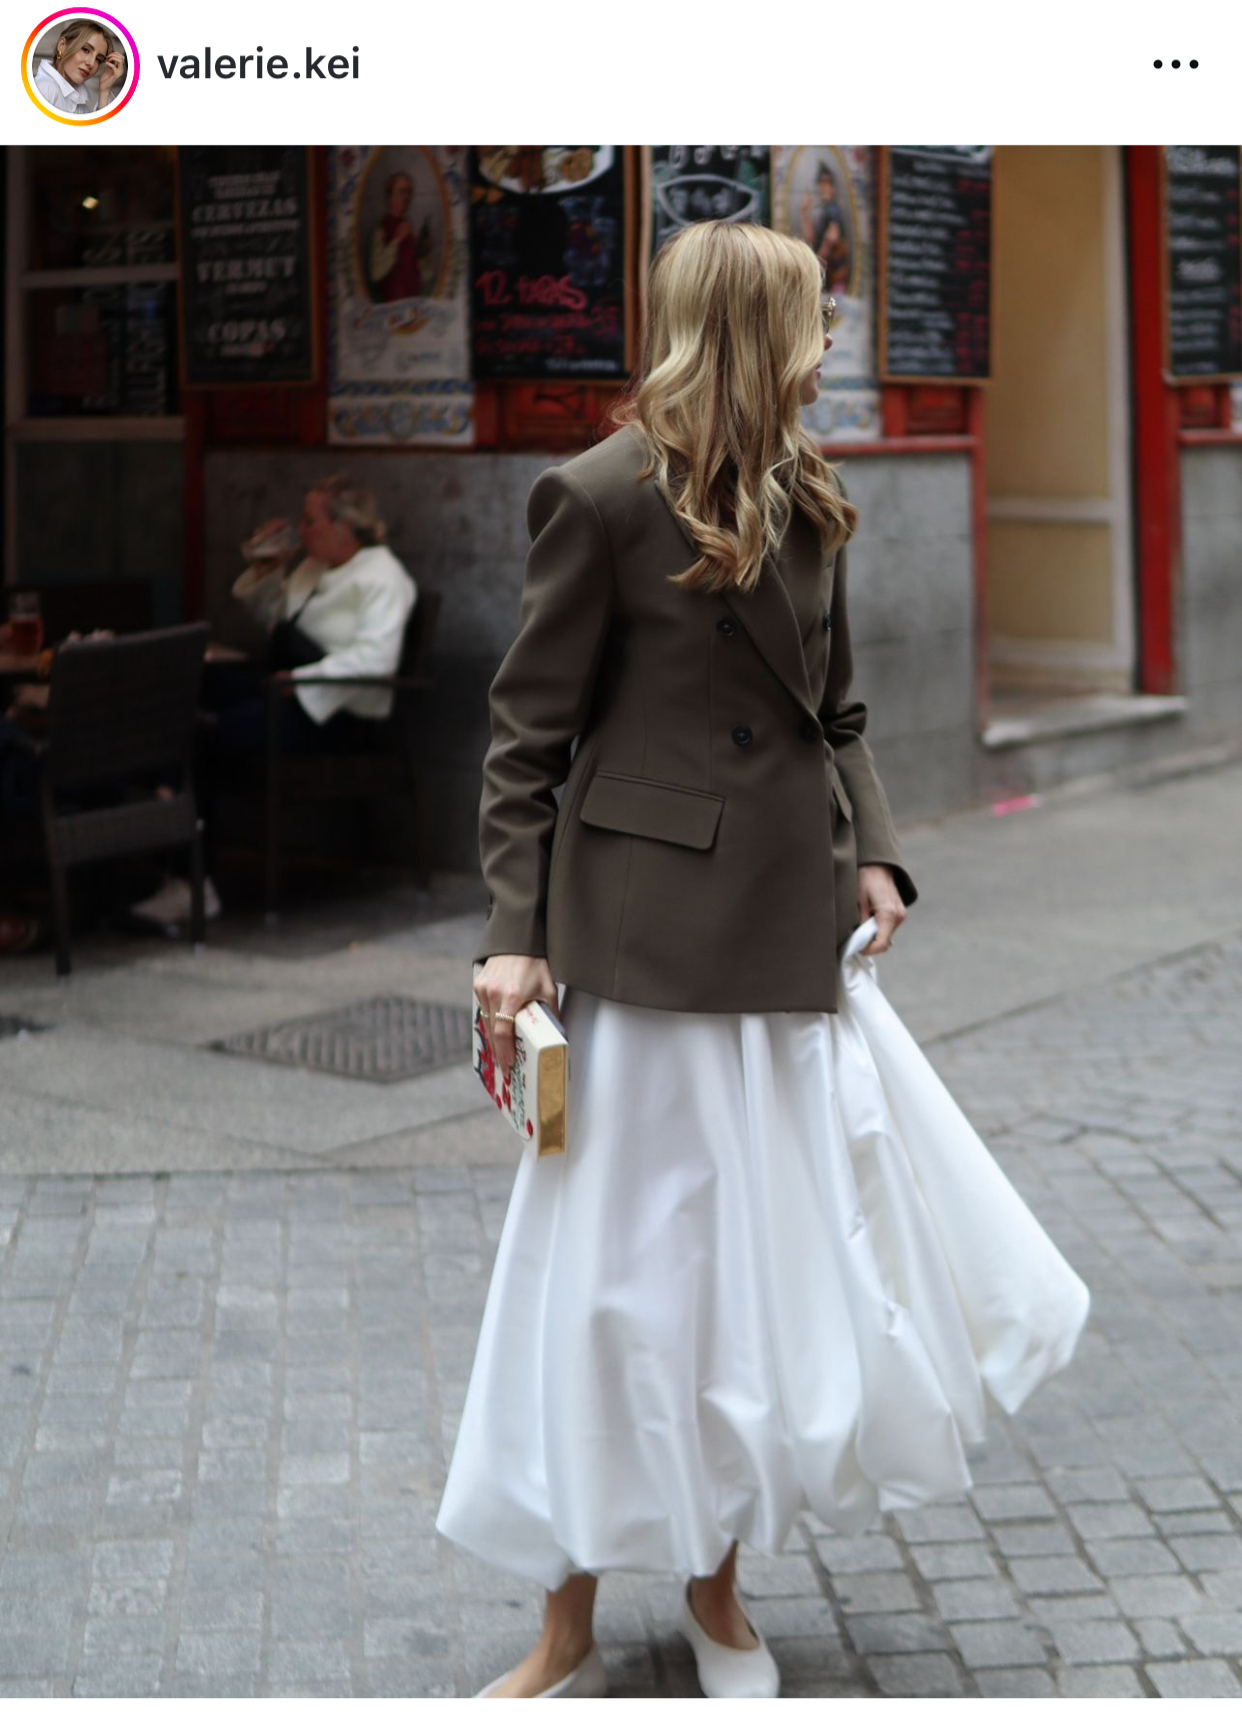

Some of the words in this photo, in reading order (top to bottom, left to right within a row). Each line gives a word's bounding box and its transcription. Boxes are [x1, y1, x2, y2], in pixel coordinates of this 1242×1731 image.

[190, 196, 299, 223] CERVEZAS
[197, 256, 296, 283] VERMUT
[207, 318, 286, 344] COPAS
